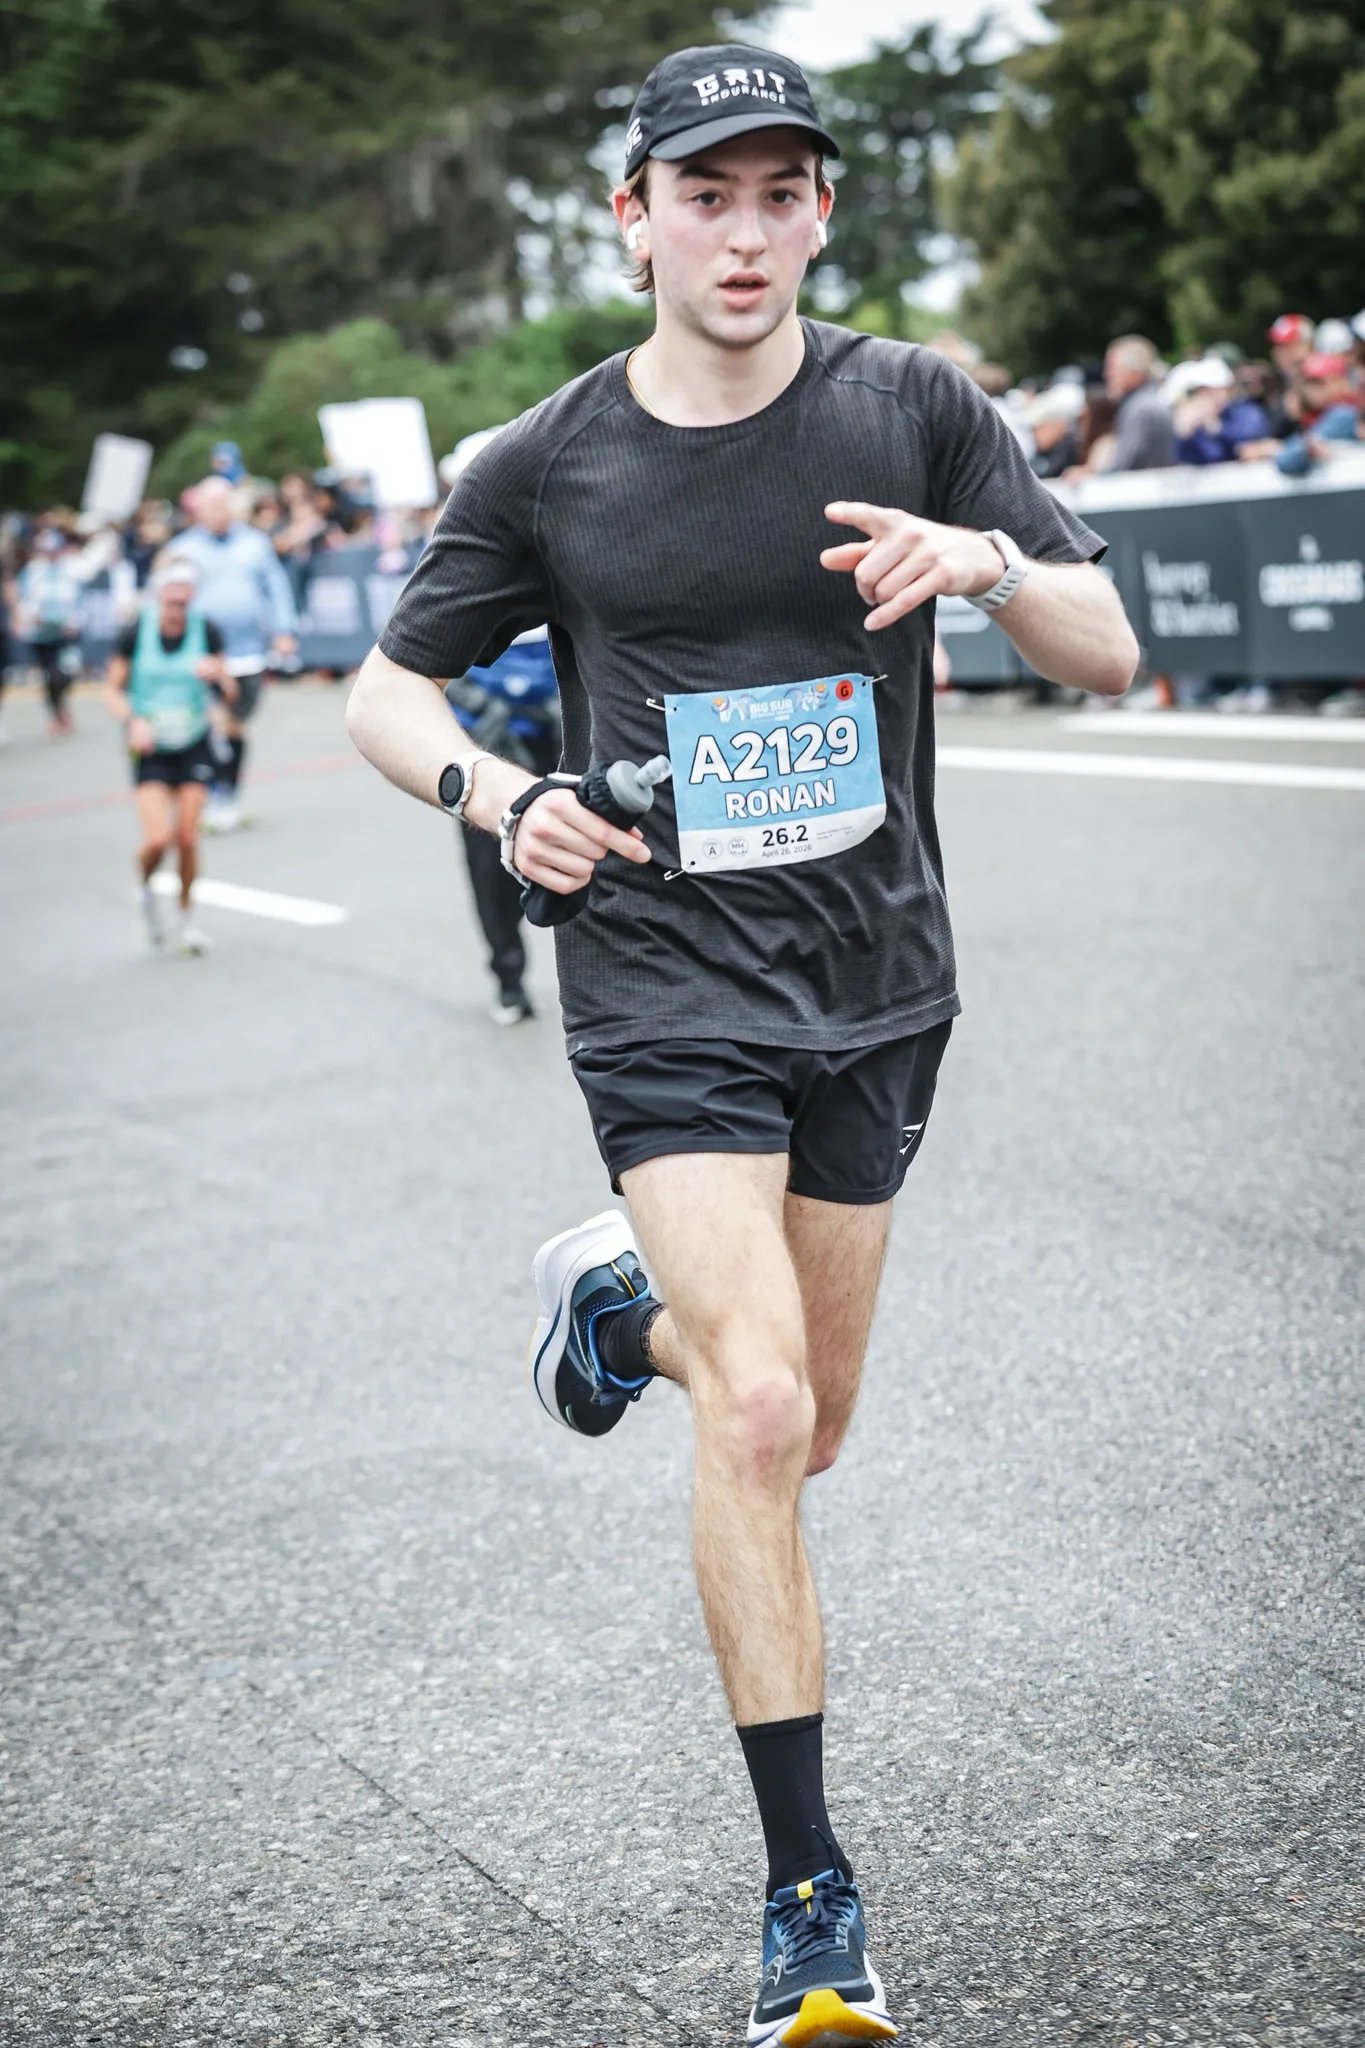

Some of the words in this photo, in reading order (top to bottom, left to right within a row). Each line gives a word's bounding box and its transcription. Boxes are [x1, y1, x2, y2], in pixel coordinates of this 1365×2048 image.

[692, 68, 786, 98] GRIT
[701, 84, 786, 107] ENDURANCE
[840, 685, 849, 698] G
[750, 702, 769, 714] BIG
[770, 699, 793, 711] SUR
[688, 715, 860, 785] A2129
[725, 778, 836, 821] RONAN
[762, 824, 809, 848] 26.2
[761, 849, 779, 859] April
[780, 847, 792, 857] 26,
[793, 843, 813, 854] 2026
